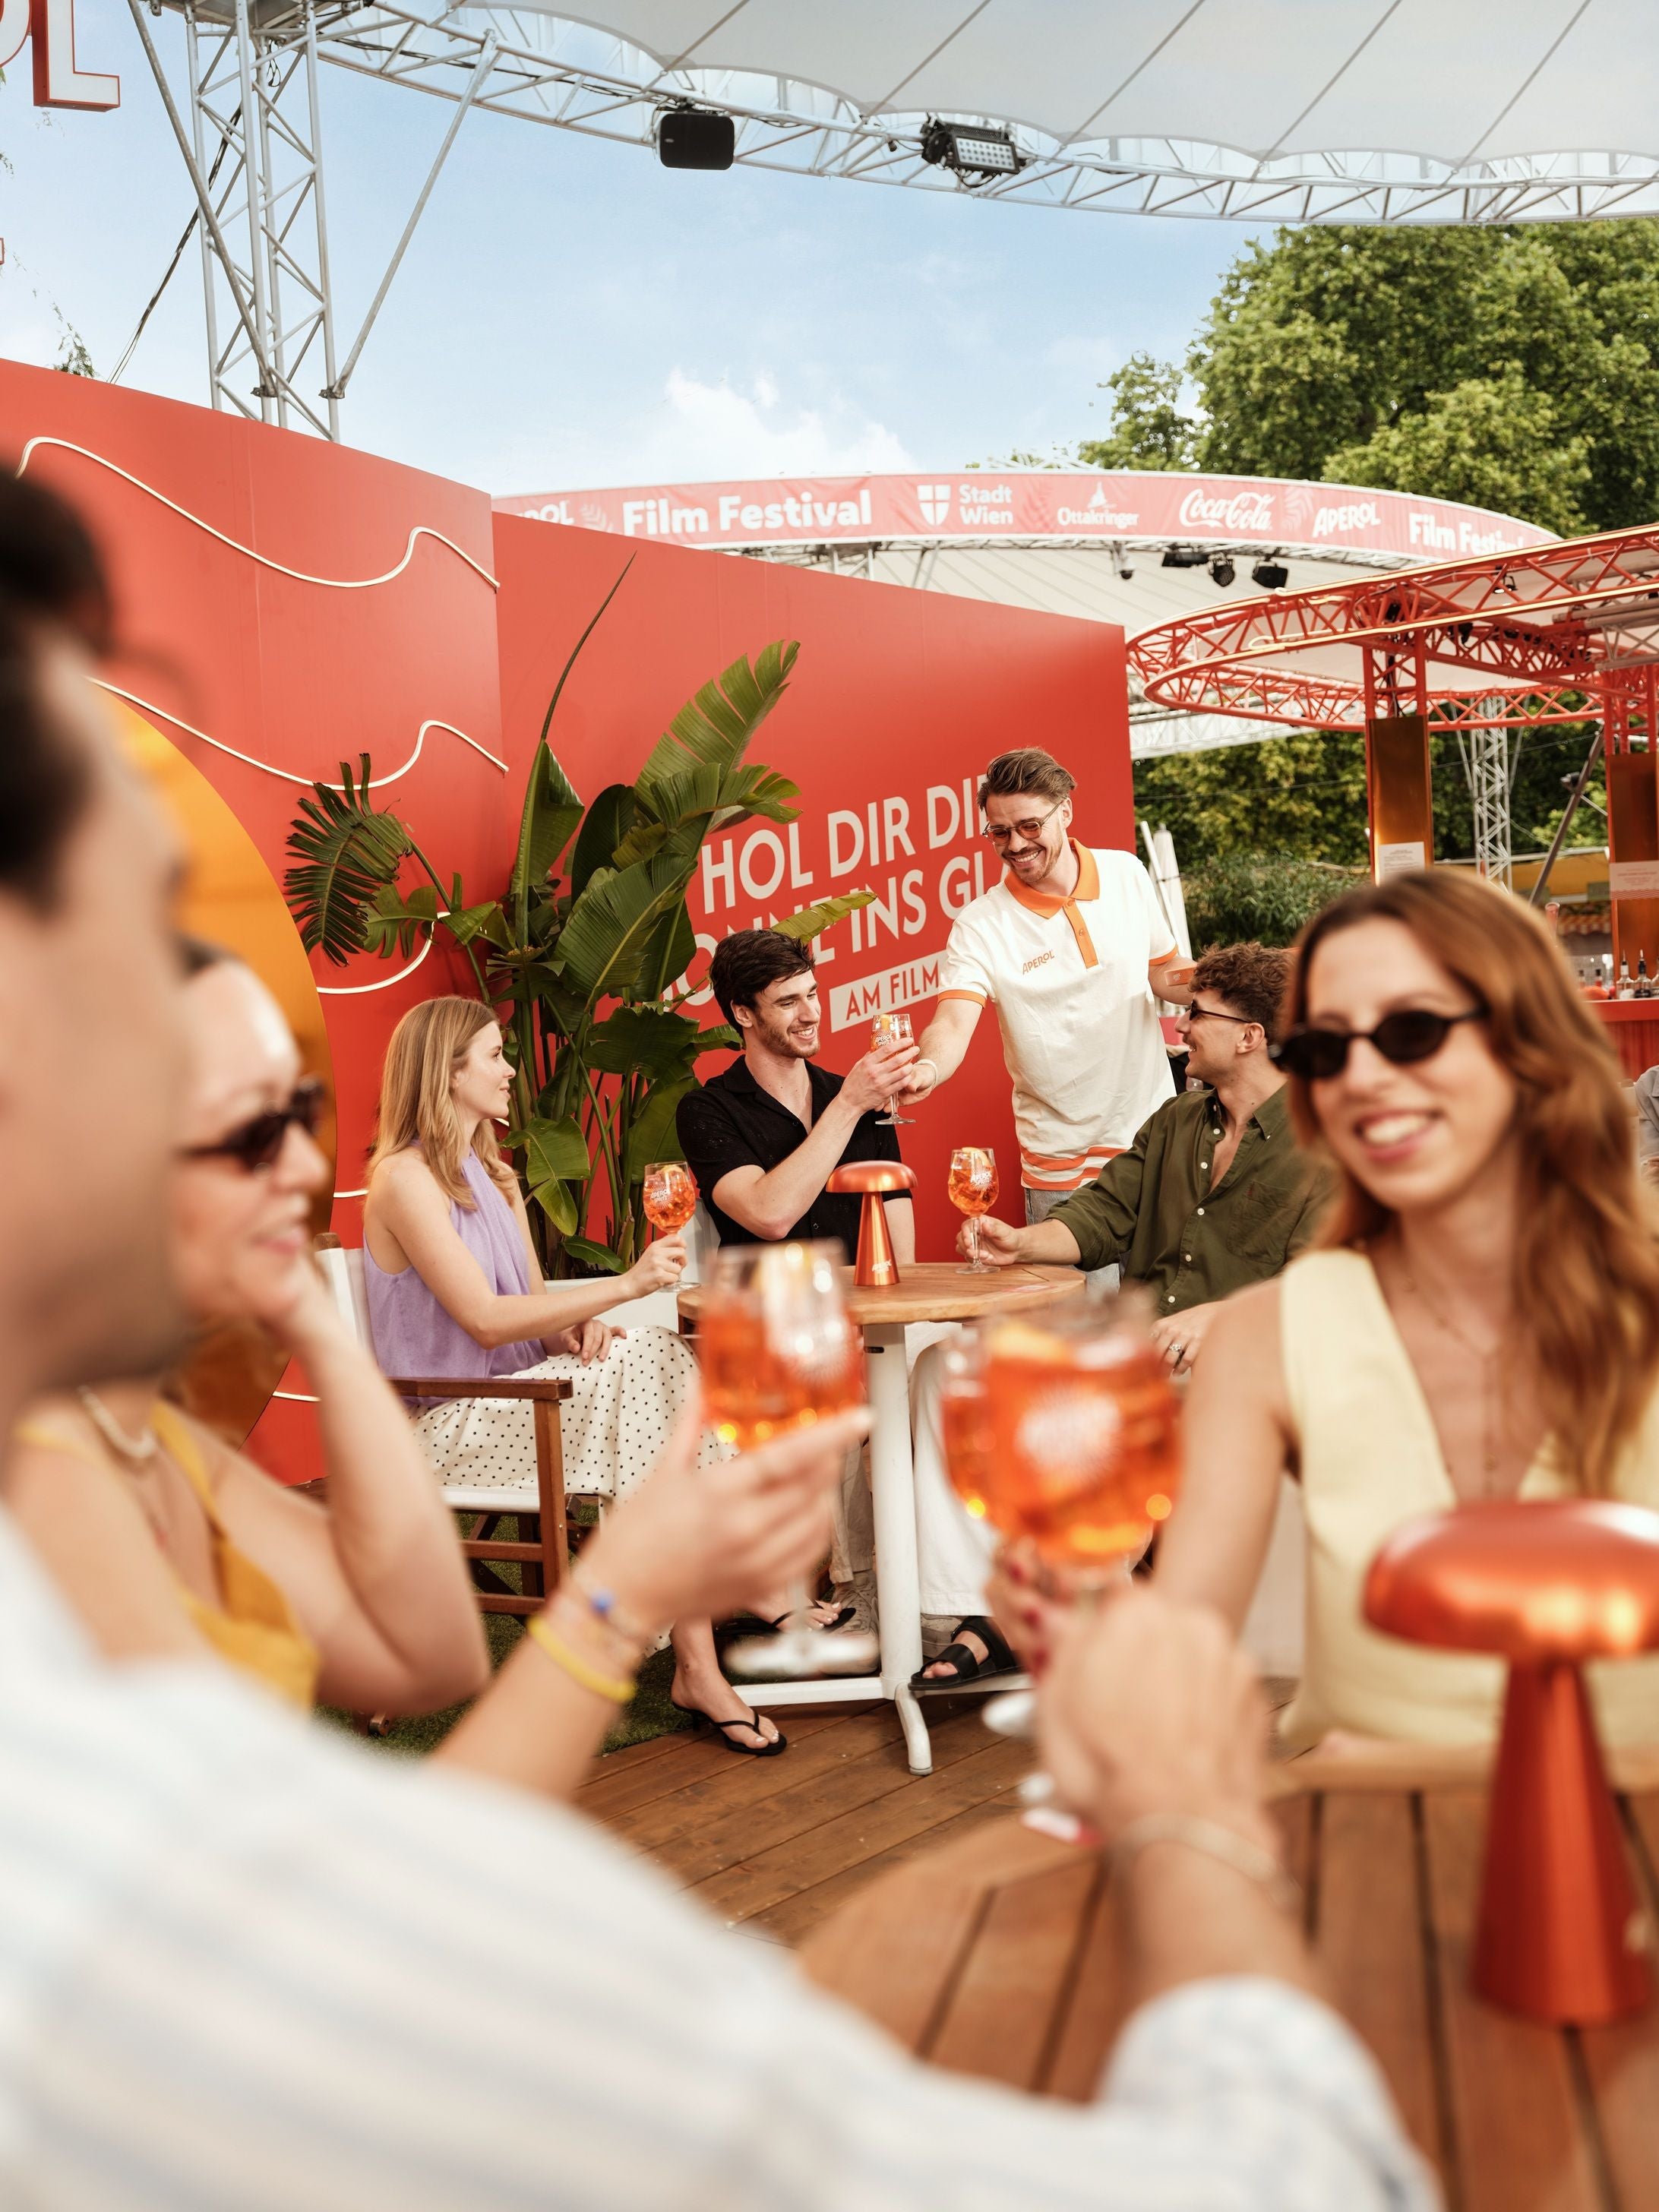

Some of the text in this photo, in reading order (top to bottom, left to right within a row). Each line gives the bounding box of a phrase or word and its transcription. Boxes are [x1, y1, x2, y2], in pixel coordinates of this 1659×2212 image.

[622, 489, 872, 536] Film Festival
[959, 484, 1013, 504] Stadt
[959, 506, 1013, 525] Wien
[1057, 507, 1139, 529] Ottakringer
[1313, 501, 1381, 538] APEROL
[1409, 513, 1457, 551] Film
[701, 823, 814, 914] HOL
[828, 796, 915, 878] DIR
[850, 869, 925, 953] INS
[1022, 950, 1055, 975] APEROL
[845, 959, 939, 1021] AM FILM
